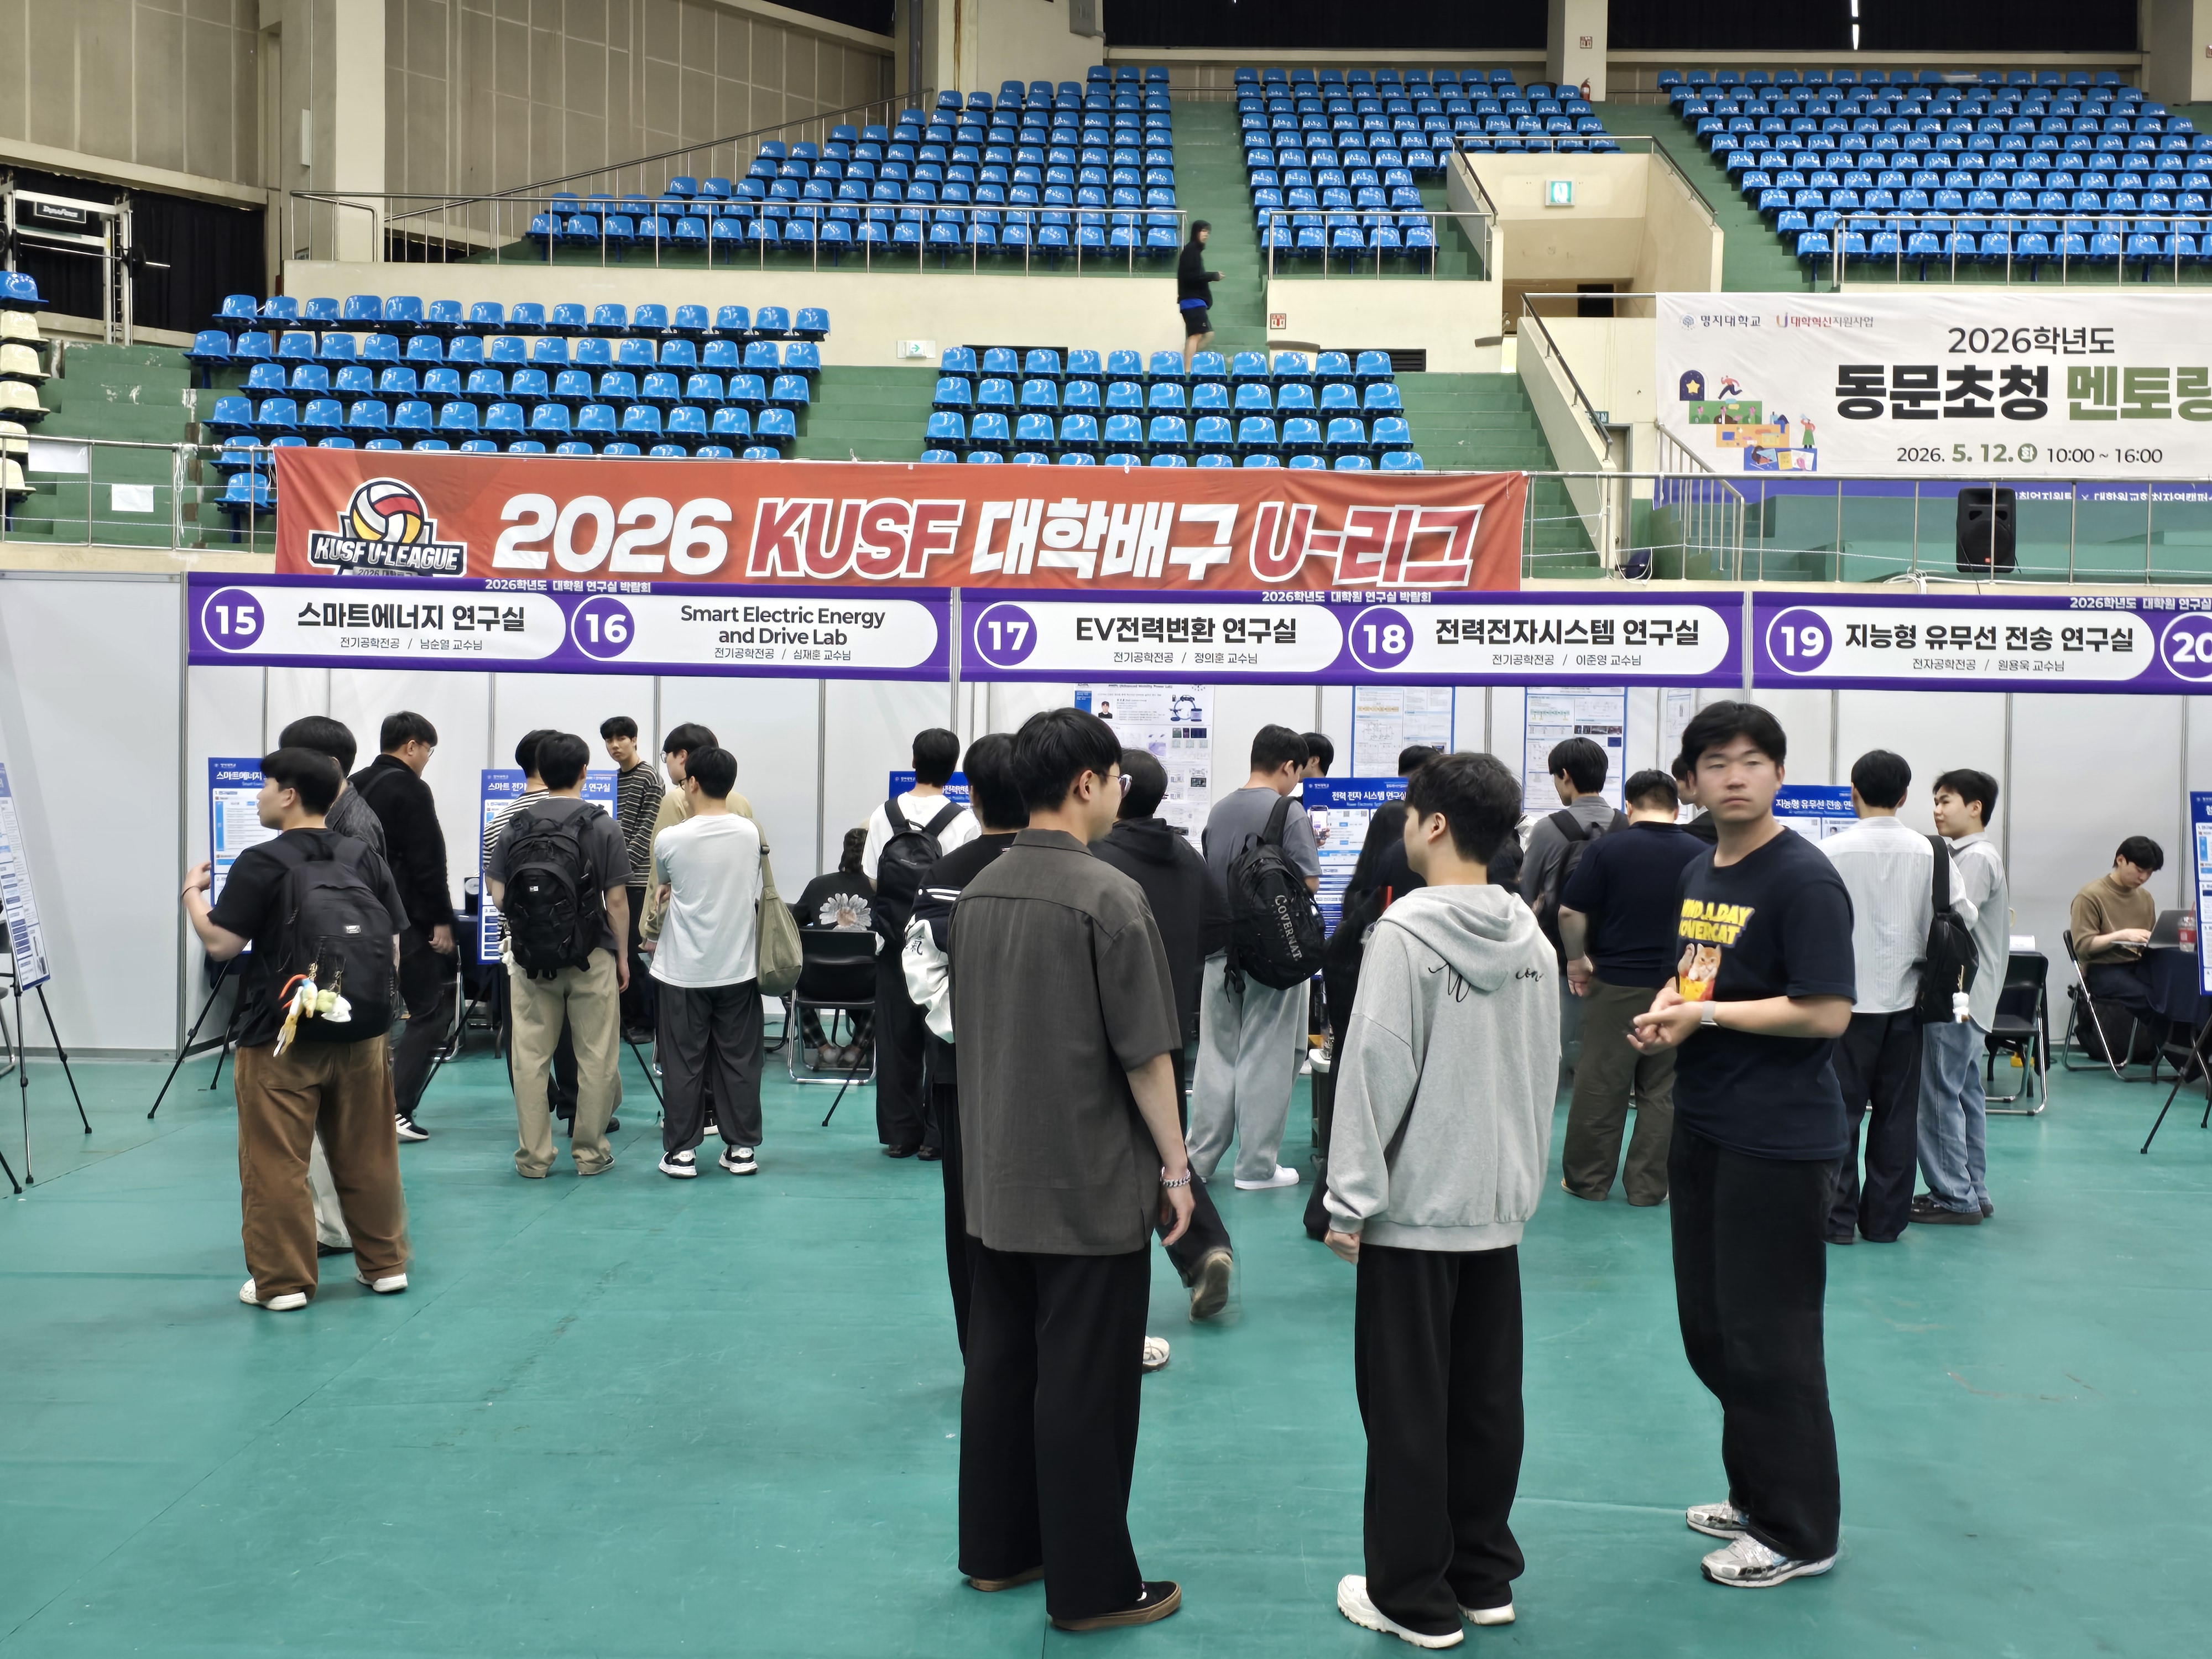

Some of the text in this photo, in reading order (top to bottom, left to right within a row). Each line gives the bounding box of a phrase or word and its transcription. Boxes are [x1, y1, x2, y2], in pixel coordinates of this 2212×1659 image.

[1700, 315, 1760, 327] 명지대학교
[1791, 316, 1874, 328] 대학혁신지원사업
[1948, 326, 2115, 354] 2026학년도
[1835, 364, 2212, 422] 동문초청 멘토링
[1897, 447, 1945, 462] 2026.
[1952, 444, 1973, 462] 5.
[1980, 444, 2013, 463] 12.
[2047, 448, 2095, 463] 10:00
[2115, 448, 2163, 463] 16:00
[492, 493, 1485, 587] 2026 KUSF 대학배구 U-리그
[314, 537, 461, 570] KUSF U-LEAGUE
[484, 578, 651, 594] 2026학년도 대학원 연구실 박람회
[1262, 591, 1432, 603] 2026학년도 대학원 연구실 박람회
[298, 601, 525, 632] 스마트에너지 연구실
[681, 604, 885, 629] Smart Electric Energy
[2070, 597, 2211, 611] 2026학년도 대학원 연구실
[215, 605, 257, 636] 15
[585, 613, 628, 644] 16
[1076, 617, 1296, 644] EV전력변환 연구실
[1436, 619, 1698, 646] 전력전자시스템 연구실
[340, 637, 400, 649] 전기공학전공
[453, 639, 482, 651] 교수님
[719, 627, 847, 645] and Drive Lab
[988, 621, 1029, 650] 17
[1363, 624, 1406, 654] 18
[1781, 626, 1824, 657] 19
[1845, 624, 2133, 653] 지능형 유무선 전송 연구실
[2172, 632, 2212, 663] 20
[714, 648, 774, 659] 전기공학전공
[794, 649, 821, 660] 심재훈
[824, 650, 851, 661] 교수님
[1114, 652, 1174, 663] 전기공학전공
[1228, 653, 1258, 664] 교수님
[1493, 654, 1554, 665] 전기공학전공
[1576, 655, 1606, 666] 이준영
[1610, 655, 1641, 666] 교수님
[1913, 658, 1976, 671] 전자공학전공
[2033, 660, 2064, 672] 교수님
[488, 782, 510, 791] 스마트
[588, 783, 611, 792] 연구실
[1332, 791, 1346, 801] 전력
[1347, 791, 1361, 801] 전자
[1363, 791, 1385, 801] 시스템
[1274, 894, 1303, 962] COVERNAT
